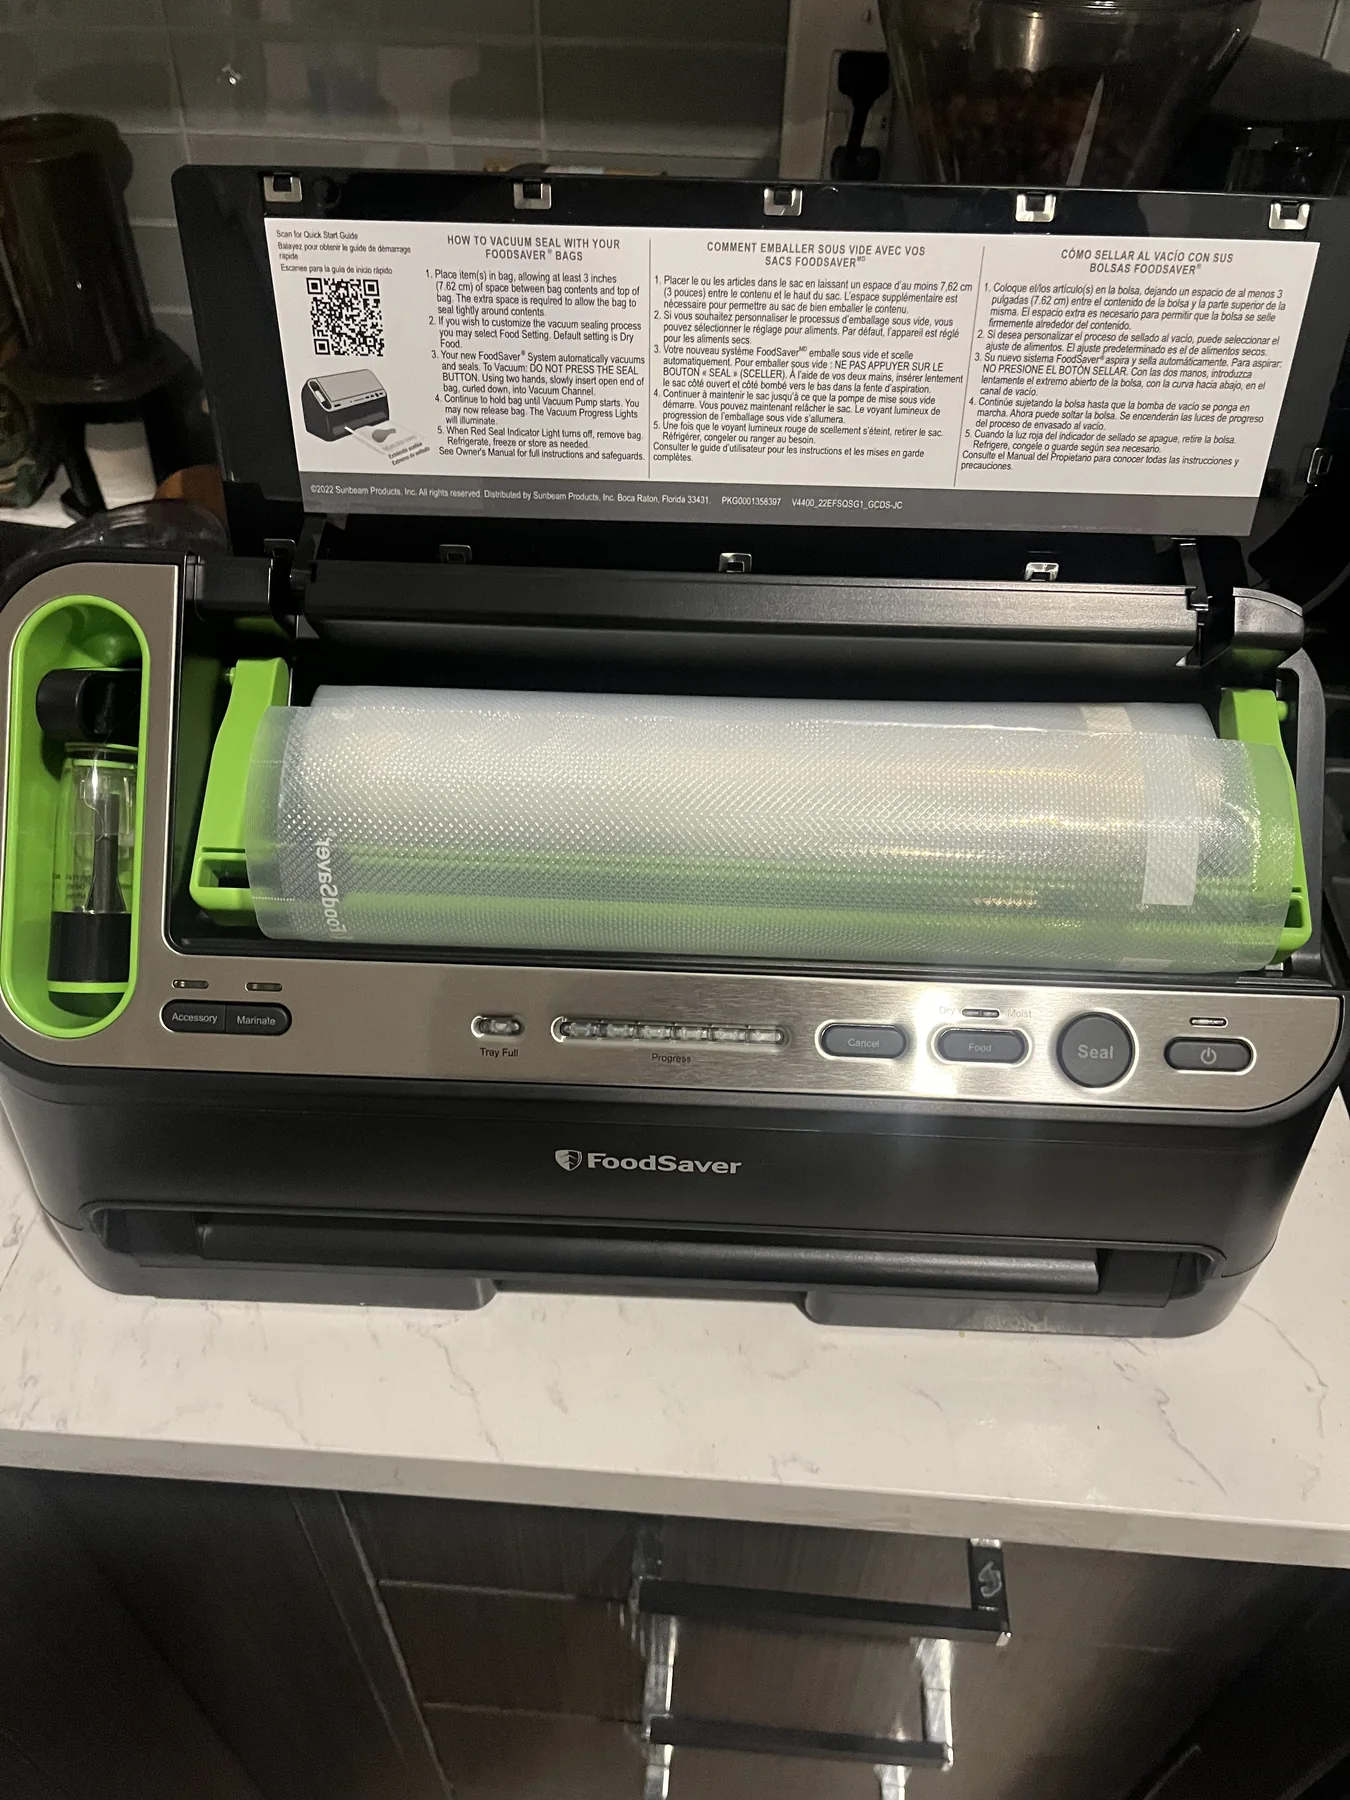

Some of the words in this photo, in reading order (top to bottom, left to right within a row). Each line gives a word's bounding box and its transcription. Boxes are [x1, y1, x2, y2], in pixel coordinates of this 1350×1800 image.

[276, 229, 292, 238] Scan
[293, 230, 302, 238] for
[303, 230, 322, 238] Quick
[322, 230, 338, 239] Start
[338, 231, 358, 239] Guide
[277, 241, 302, 251] Balayez
[341, 243, 348, 251] le
[348, 243, 366, 253] guide
[367, 243, 376, 252] de
[447, 235, 470, 245] HOW
[474, 236, 487, 245] TO
[489, 236, 532, 246] VACUUM
[535, 237, 561, 247] SEAL
[563, 238, 588, 248] WITH
[592, 238, 619, 248] YOUR
[706, 241, 756, 252] COMMENT
[760, 243, 814, 253] EMBALLER
[818, 244, 845, 254] SOUS
[848, 244, 872, 254] VIDE
[874, 245, 901, 255] AVEC
[904, 246, 925, 256] VOS
[1060, 247, 1092, 259] CÓMO
[1094, 250, 1134, 260] SELLAR
[1136, 250, 1151, 260] AL
[1153, 249, 1185, 261] VACÍO
[1187, 252, 1210, 262] CON
[1212, 252, 1233, 262] SUS
[555, 250, 582, 260] BAGS
[765, 255, 791, 265] SACS
[323, 264, 330, 272] la
[346, 265, 354, 273] de
[1089, 262, 1131, 272] BOLSAS
[426, 269, 432, 278] 1.
[434, 270, 457, 279] Place
[459, 270, 486, 282] item(s)
[488, 271, 496, 280] in
[498, 271, 515, 282] bag,
[517, 272, 550, 283] allowing
[552, 272, 560, 281] at
[562, 273, 581, 282] least
[583, 273, 588, 282] 3
[590, 273, 616, 282] inches
[458, 284, 473, 293] cm)
[475, 282, 483, 291] of
[485, 285, 509, 294] space
[511, 284, 544, 293] between
[546, 284, 562, 295] bag
[563, 285, 597, 294] contents
[600, 286, 614, 294] and
[617, 286, 630, 297] top
[631, 286, 639, 295] of
[436, 293, 453, 304] bag.
[457, 294, 471, 303] The
[473, 294, 493, 303] extra
[495, 297, 519, 306] space
[521, 296, 528, 304] is
[530, 296, 562, 307] required
[564, 296, 572, 305] to
[574, 297, 595, 306] allow
[596, 297, 609, 306] the
[611, 297, 626, 308] bag
[628, 298, 636, 307] to
[437, 305, 454, 314] seal
[455, 305, 479, 316] tightly
[480, 306, 508, 315] around
[510, 307, 546, 316] contents.
[441, 361, 456, 370] and
[458, 362, 480, 370] seals.
[484, 362, 492, 371] To
[494, 363, 527, 372] Vacuum:
[529, 364, 543, 372] DO
[544, 364, 562, 372] NOT
[565, 365, 594, 373] PRESS
[597, 365, 613, 374] THE
[616, 366, 638, 374] SEAL
[982, 364, 996, 372] NO
[998, 364, 1044, 373] PRESIONE
[1045, 365, 1057, 374] EL
[1058, 364, 1090, 374] BOTÓN
[1092, 366, 1129, 375] SELLAR.
[1130, 367, 1148, 376] Con
[1149, 368, 1161, 376] las
[1162, 368, 1178, 377] dos
[1211, 369, 1252, 378] introduzca
[653, 421, 660, 429] 5.
[662, 421, 678, 430] Une
[680, 422, 694, 430] fois
[695, 424, 710, 432] que
[712, 422, 719, 430] le
[720, 423, 746, 433] voyant
[748, 424, 782, 432] lumineux
[784, 426, 806, 434] rouge
[807, 425, 818, 433] de
[820, 425, 860, 434] scellement
[894, 427, 917, 435] retirer
[918, 428, 925, 436] le
[438, 447, 453, 455] See
[455, 447, 486, 456] Owner's
[487, 448, 515, 456] Manual
[528, 449, 539, 457] full
[541, 450, 583, 458] instructions
[585, 450, 599, 458] and
[429, 488, 448, 498] rights
[484, 490, 521, 498] Distributed
[522, 491, 531, 500] by
[533, 491, 566, 499] Sunbeam
[940, 1006, 956, 1016] Dry
[1008, 1010, 1032, 1018] Moist
[172, 1012, 218, 1024] Accessory
[236, 1016, 276, 1025] Marinate
[848, 1038, 880, 1048] Cancel
[968, 1042, 992, 1052] Food
[480, 1048, 500, 1058] Tray
[502, 1048, 518, 1057] Full
[1078, 1044, 1114, 1060] Seal
[652, 1053, 691, 1064] Progress
[588, 1152, 742, 1174] FoodSaver
